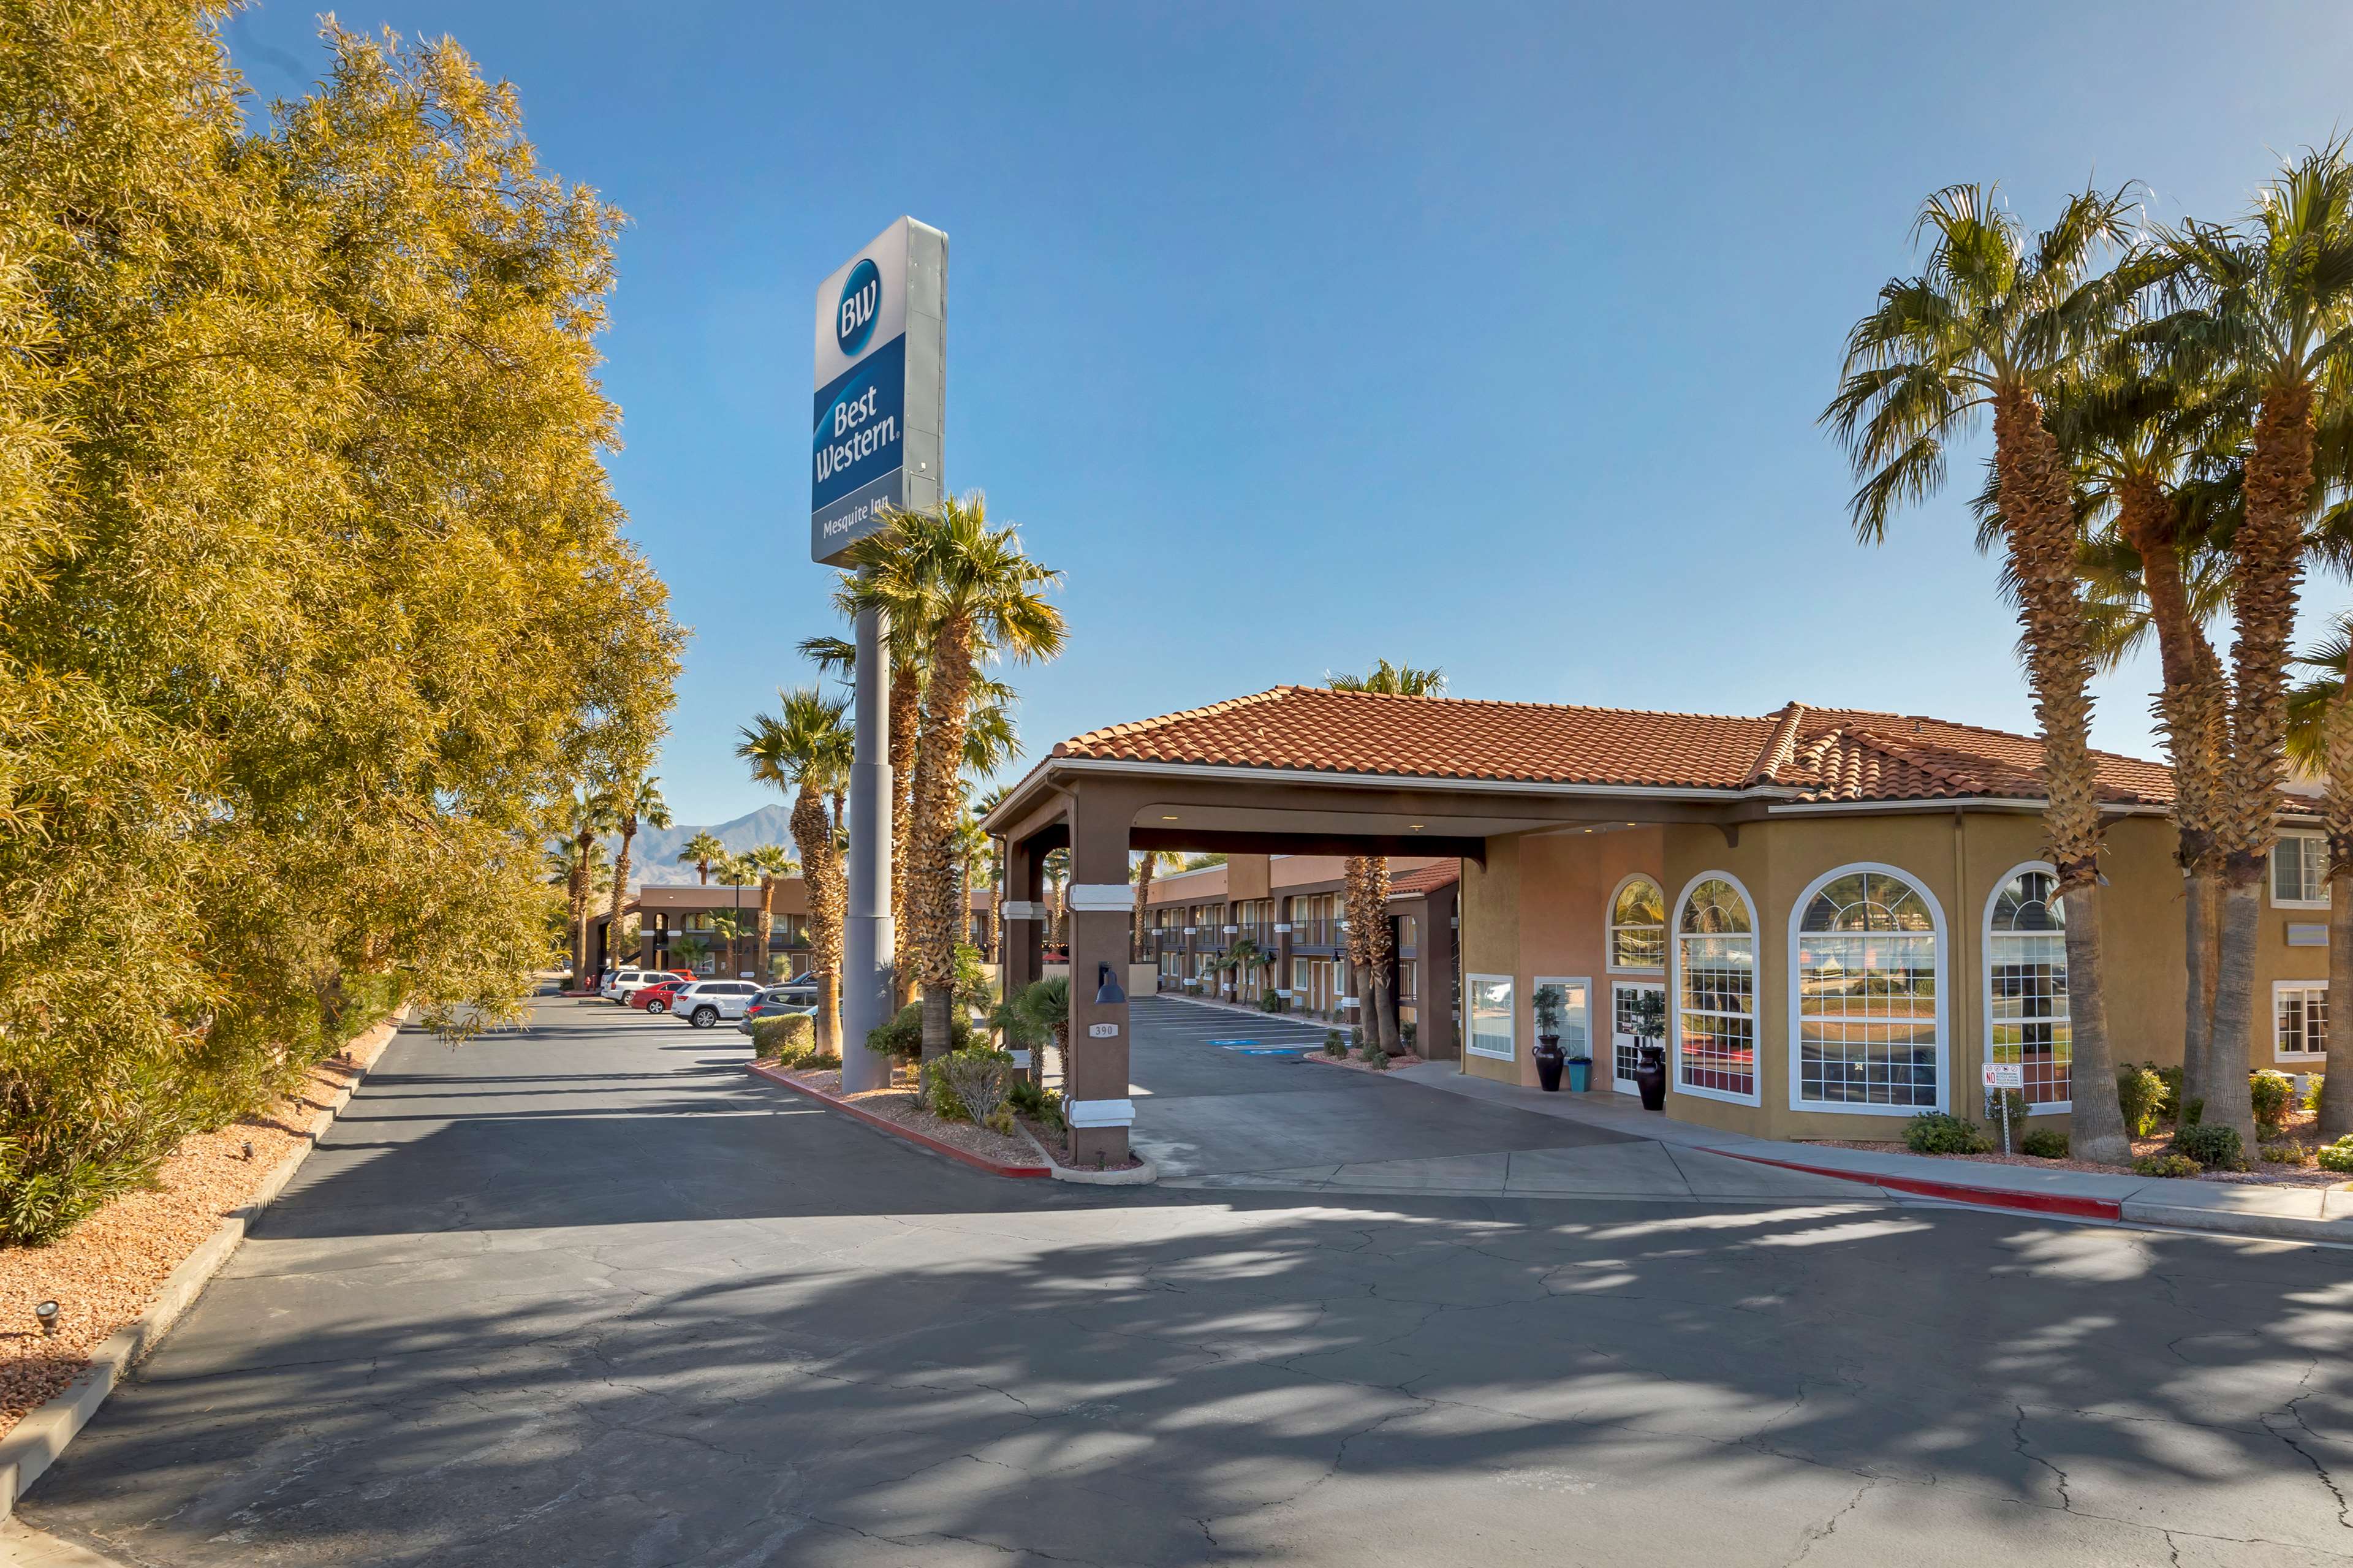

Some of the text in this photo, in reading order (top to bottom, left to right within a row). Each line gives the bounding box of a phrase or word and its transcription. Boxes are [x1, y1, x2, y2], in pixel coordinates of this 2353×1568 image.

[841, 280, 876, 338] BW
[835, 385, 877, 437] Best
[816, 415, 895, 483] Western
[823, 495, 888, 539] Mesquite Inn
[1096, 1026, 1112, 1036] 390
[1987, 1072, 1995, 1084] NO
